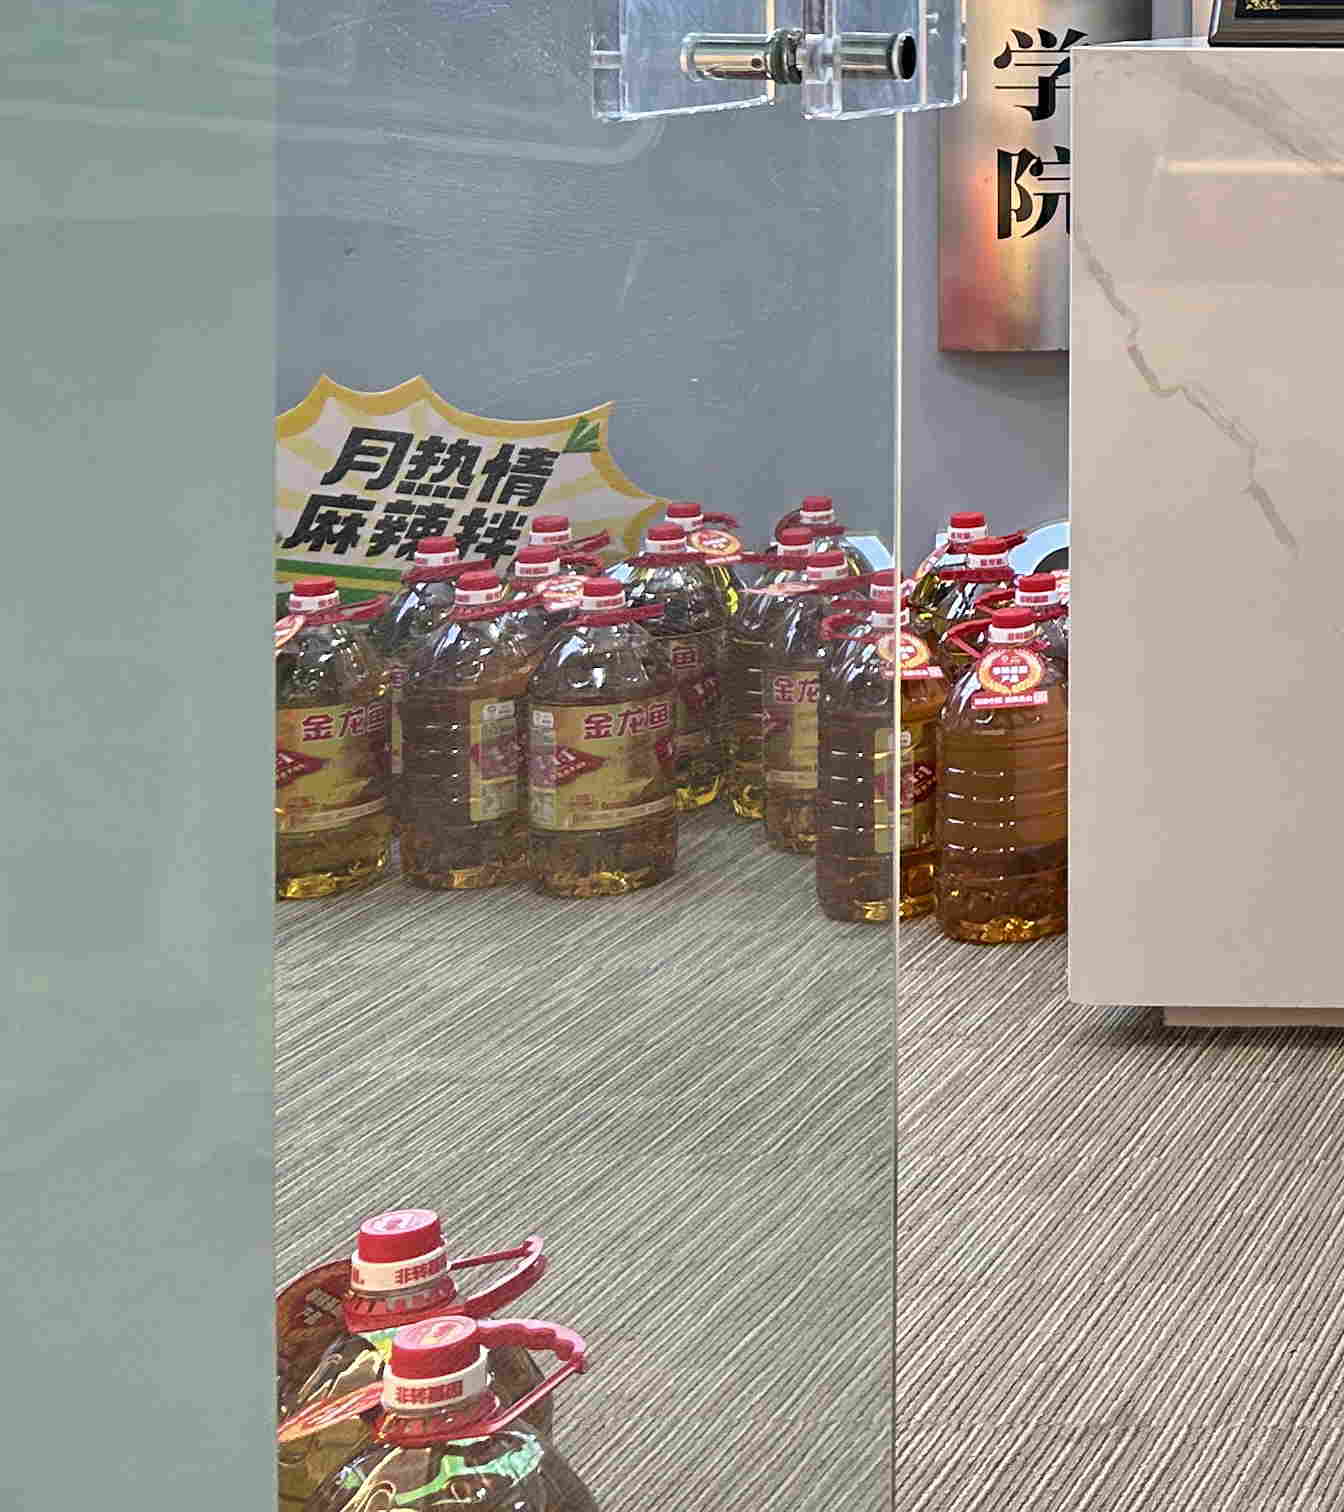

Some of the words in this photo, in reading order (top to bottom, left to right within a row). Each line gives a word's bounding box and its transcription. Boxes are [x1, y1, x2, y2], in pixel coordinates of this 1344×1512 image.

[321, 427, 561, 507] 月热情
[282, 494, 528, 565] 麻辣拌
[302, 702, 386, 743] 金龙鱼
[583, 702, 674, 741] 金龙鱼
